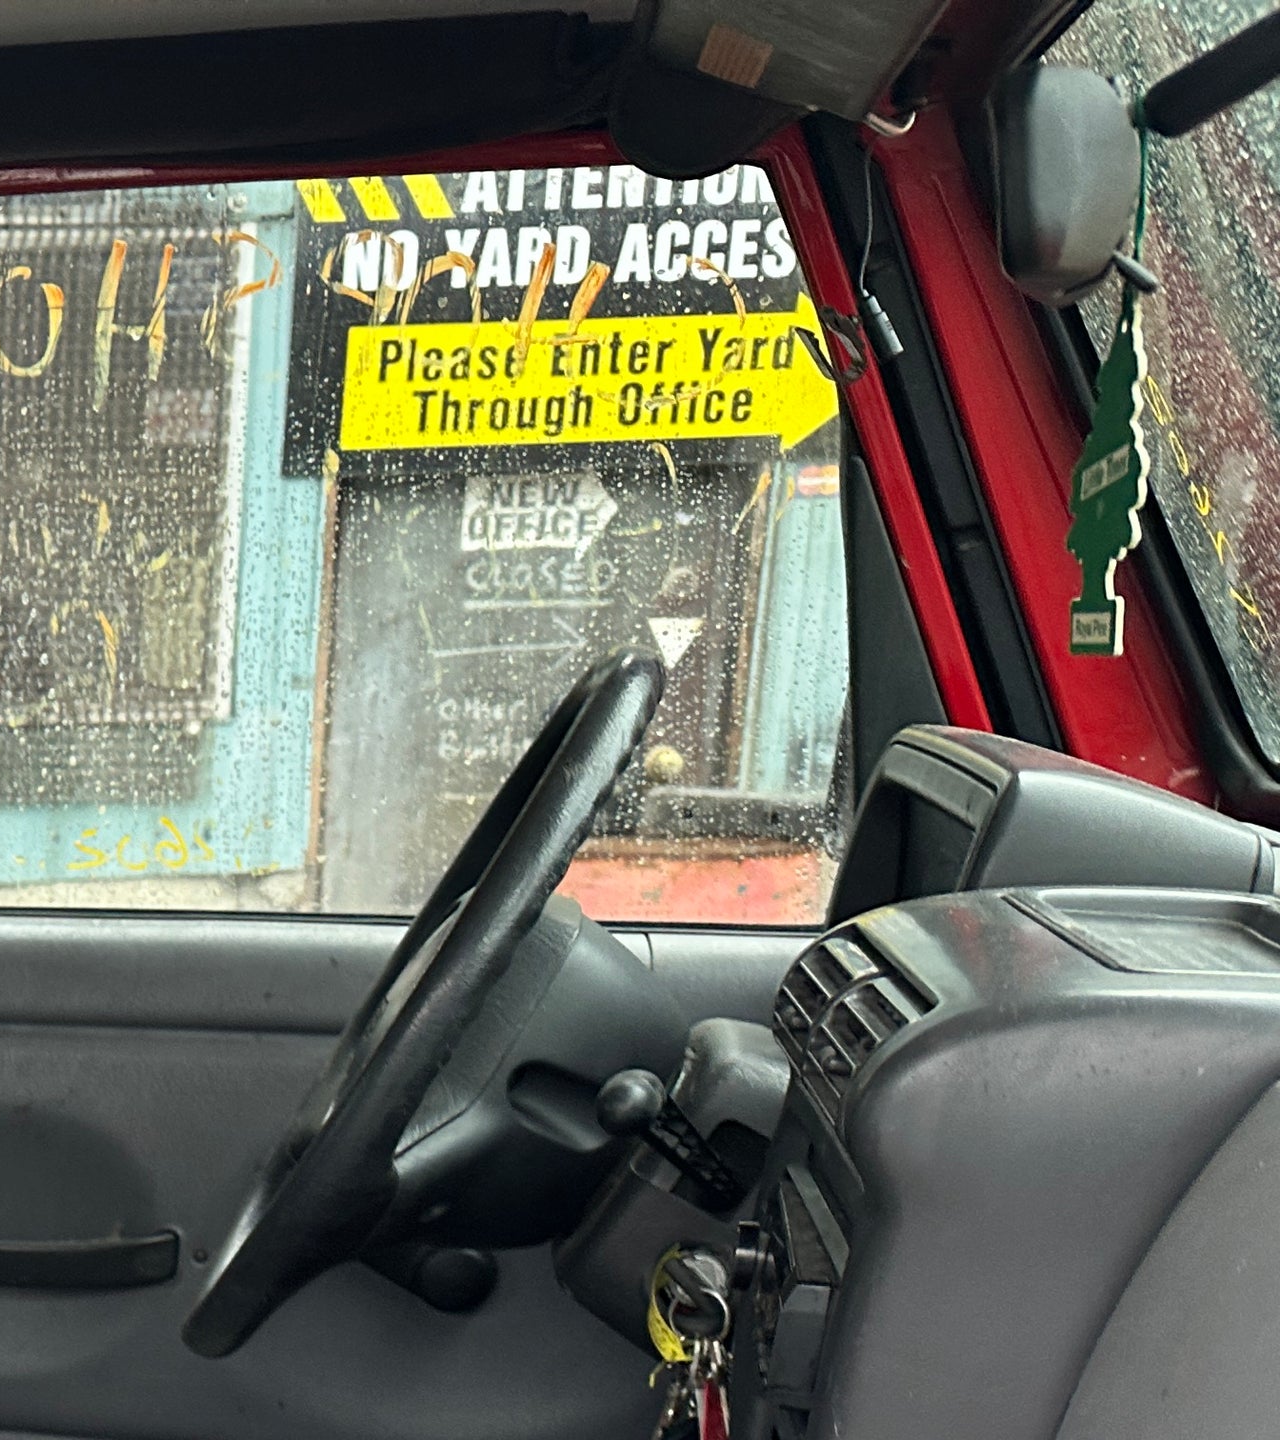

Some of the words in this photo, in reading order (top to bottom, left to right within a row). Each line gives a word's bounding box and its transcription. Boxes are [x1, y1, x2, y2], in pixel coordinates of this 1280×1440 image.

[342, 230, 421, 292] NO
[443, 224, 592, 289] YARD
[377, 338, 522, 385] Please
[550, 330, 675, 377] Enter
[697, 326, 797, 373] Yard
[412, 386, 593, 437] Through
[618, 382, 754, 426] Office
[489, 477, 580, 509] NEW
[468, 507, 598, 541] OFFICE
